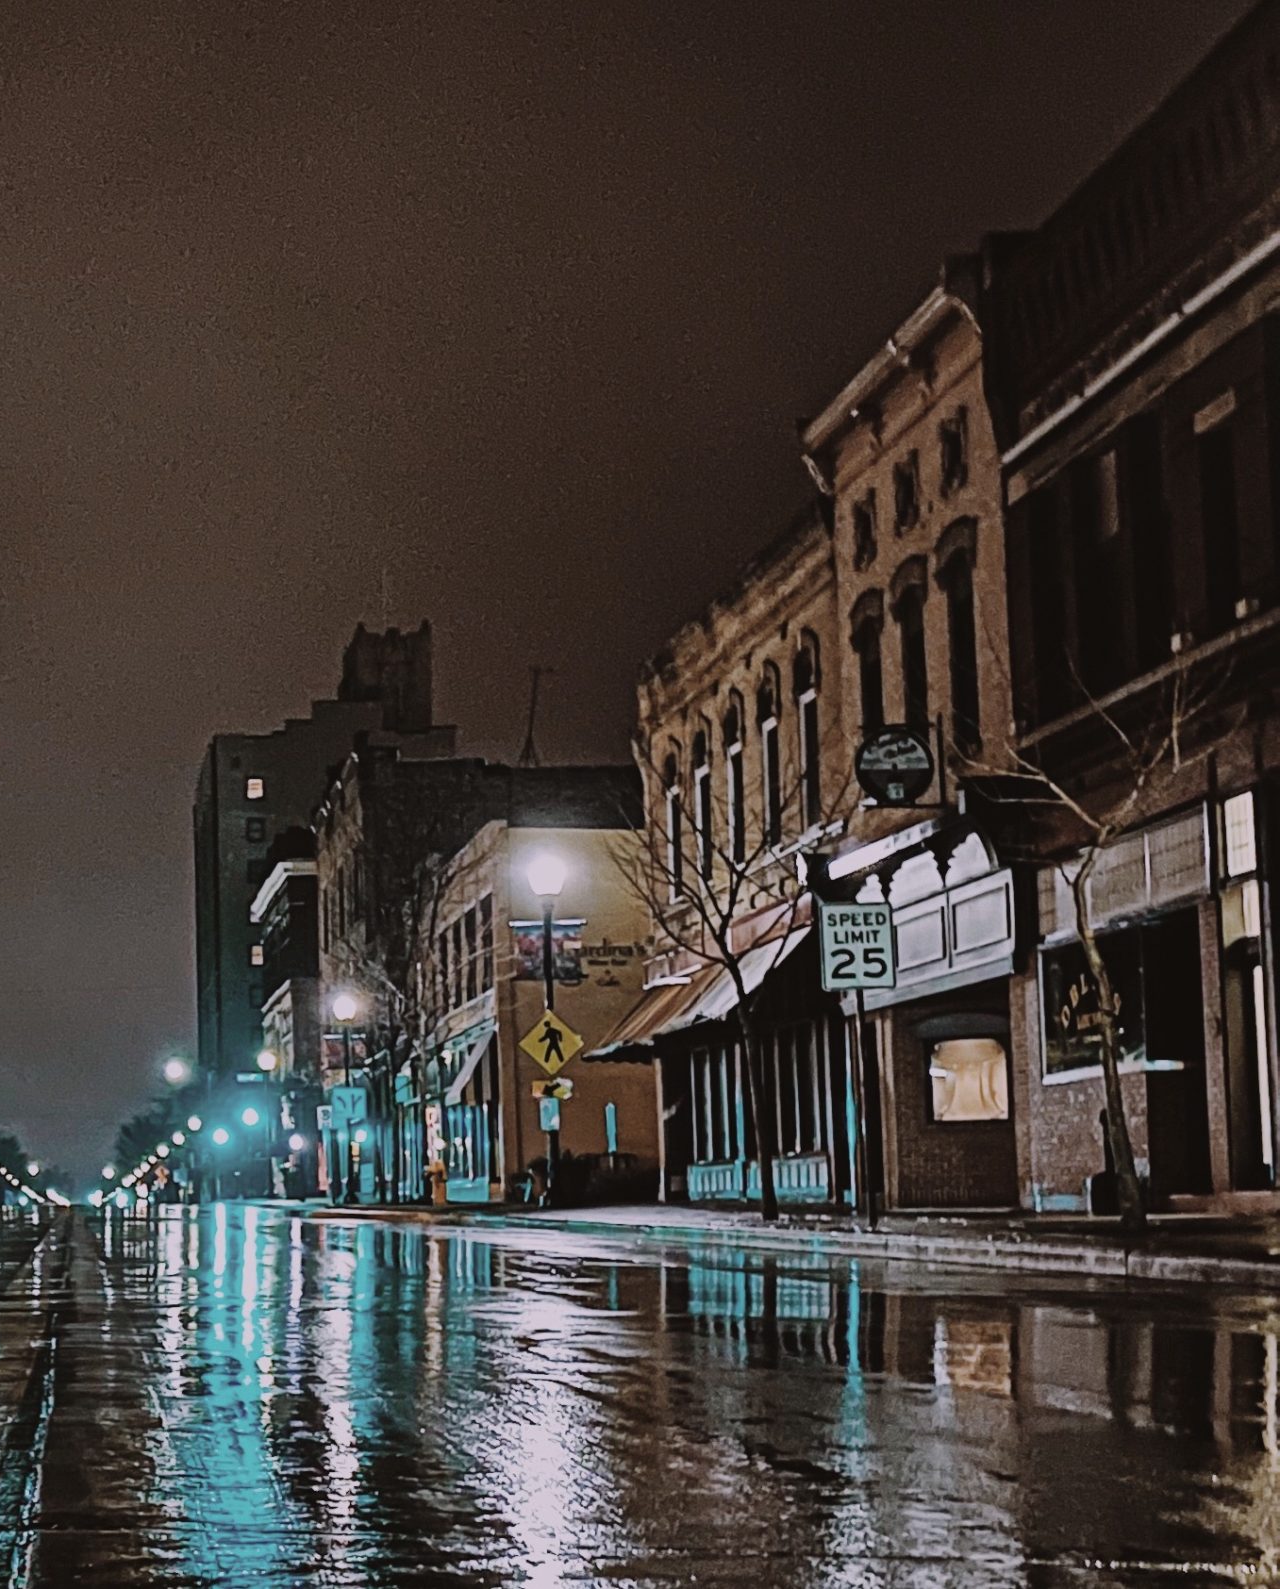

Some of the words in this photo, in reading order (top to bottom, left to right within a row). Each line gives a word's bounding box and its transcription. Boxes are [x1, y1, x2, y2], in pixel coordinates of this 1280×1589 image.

[827, 912, 887, 927] SPEED
[834, 930, 880, 944] LIMIT
[830, 947, 888, 979] 25
